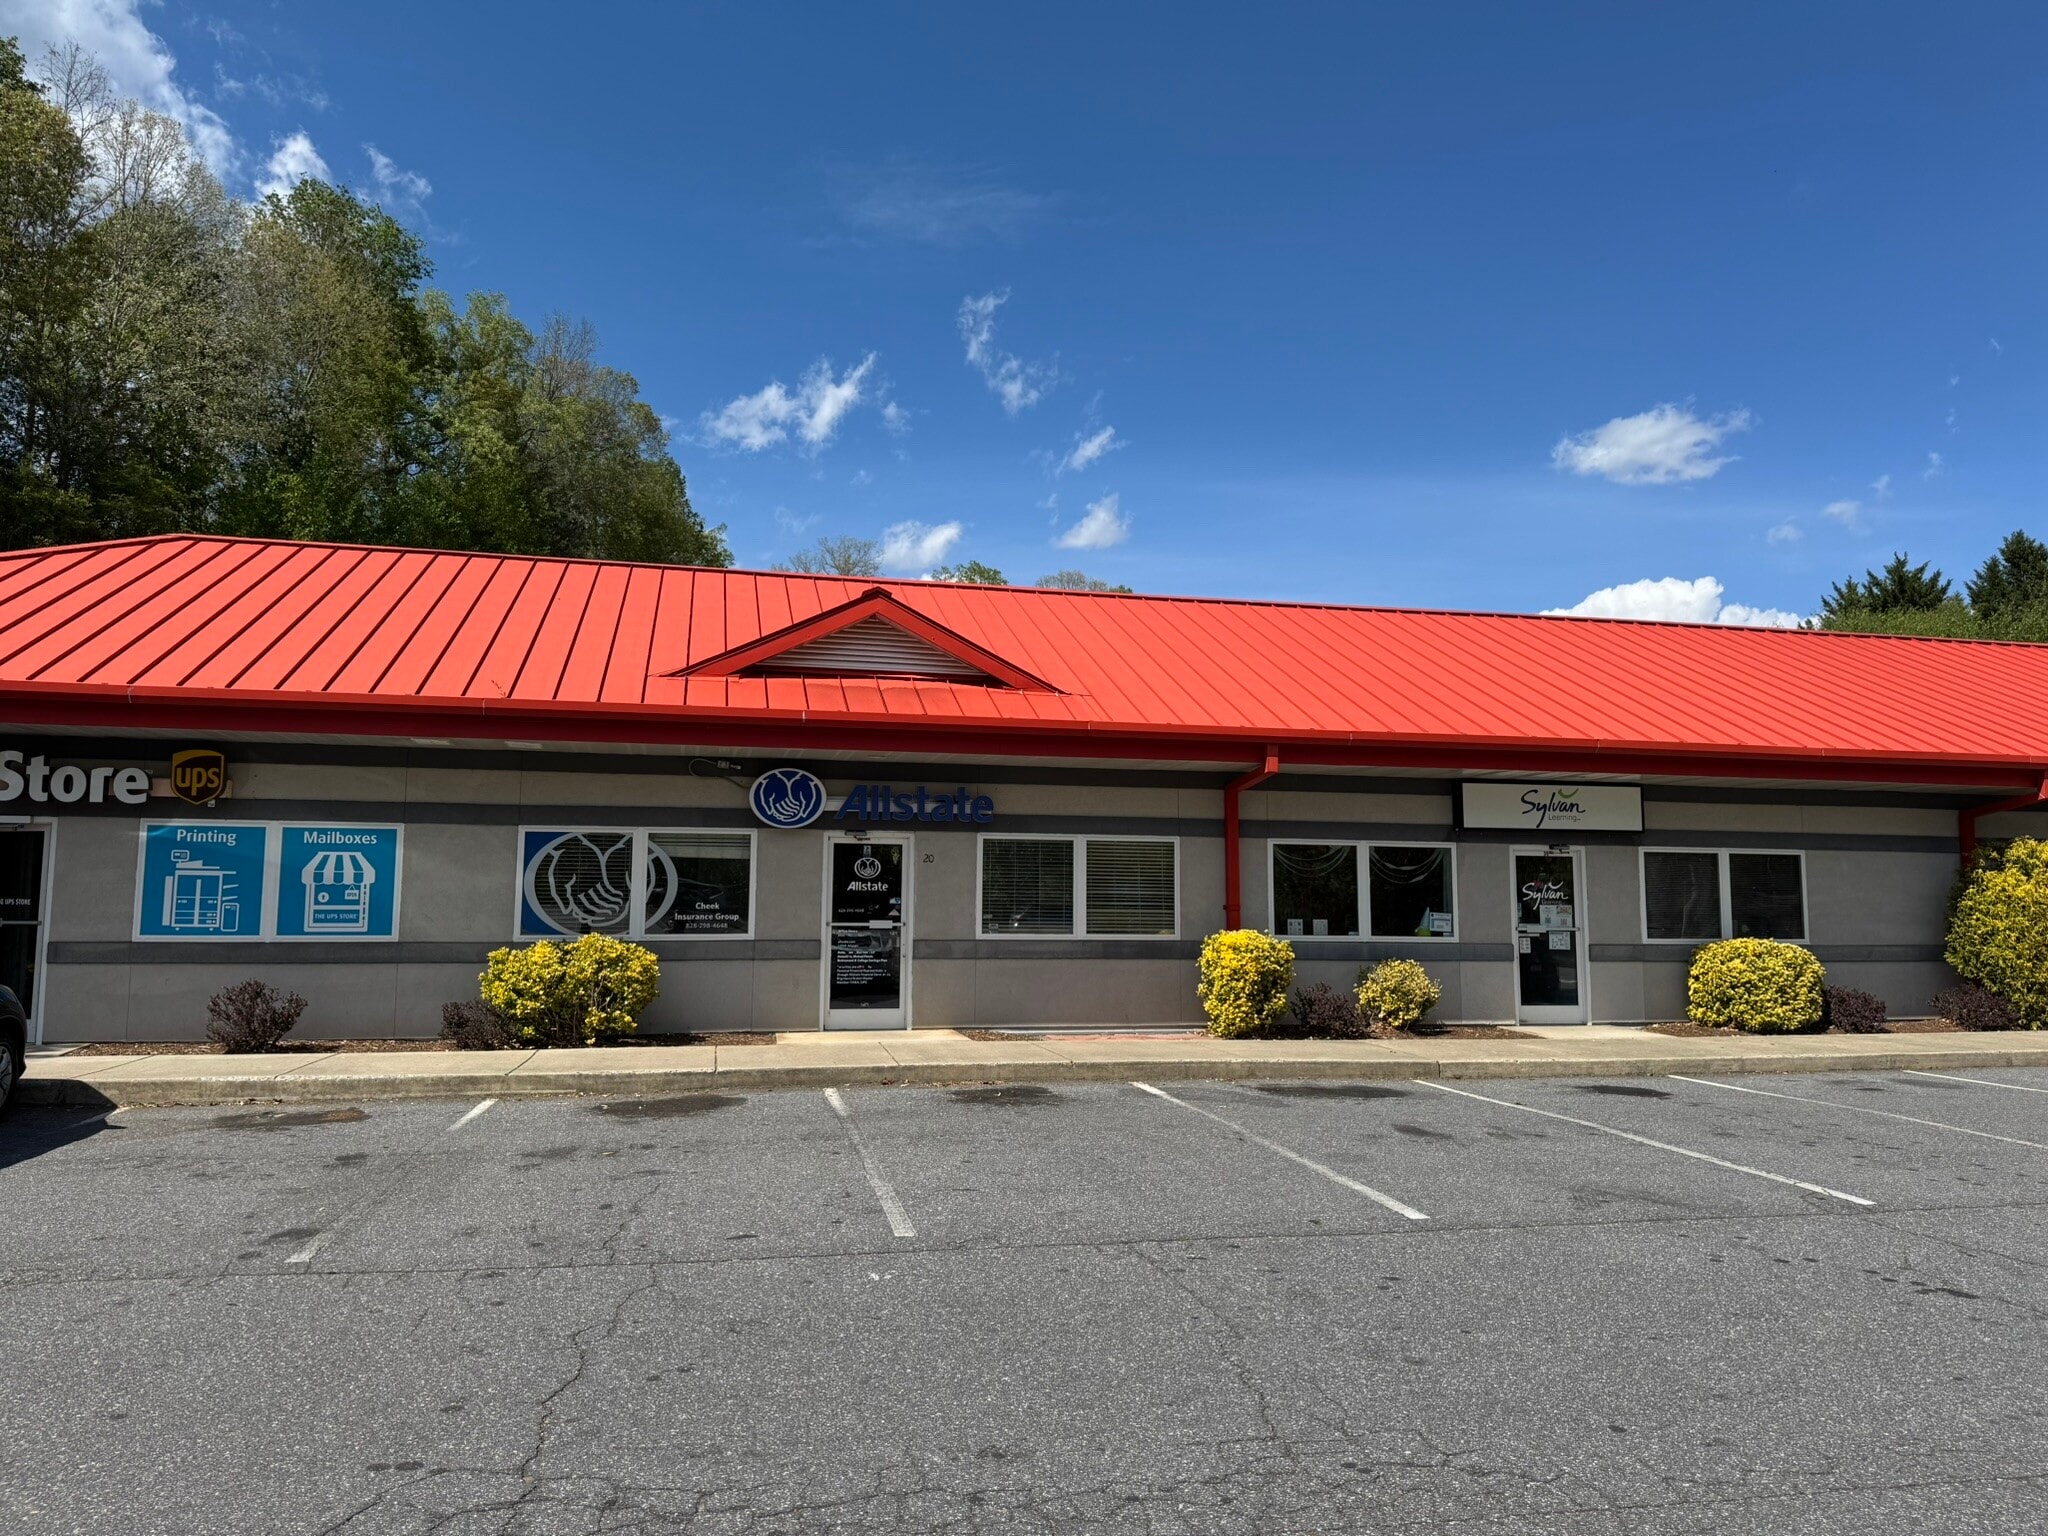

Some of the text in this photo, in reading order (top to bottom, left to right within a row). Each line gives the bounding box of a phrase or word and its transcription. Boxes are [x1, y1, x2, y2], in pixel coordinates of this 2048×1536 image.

[0, 750, 149, 804] Store
[176, 767, 220, 796] ups
[834, 784, 994, 823] Allstate
[1520, 789, 1586, 828] Sylvan
[176, 829, 237, 846] Printing
[303, 831, 377, 844] Mailboxes
[922, 853, 934, 863] 20
[847, 881, 888, 892] Allstate
[1521, 882, 1569, 911] Sylvan
[695, 902, 720, 910] Cheek
[674, 912, 740, 922] Insurance Group
